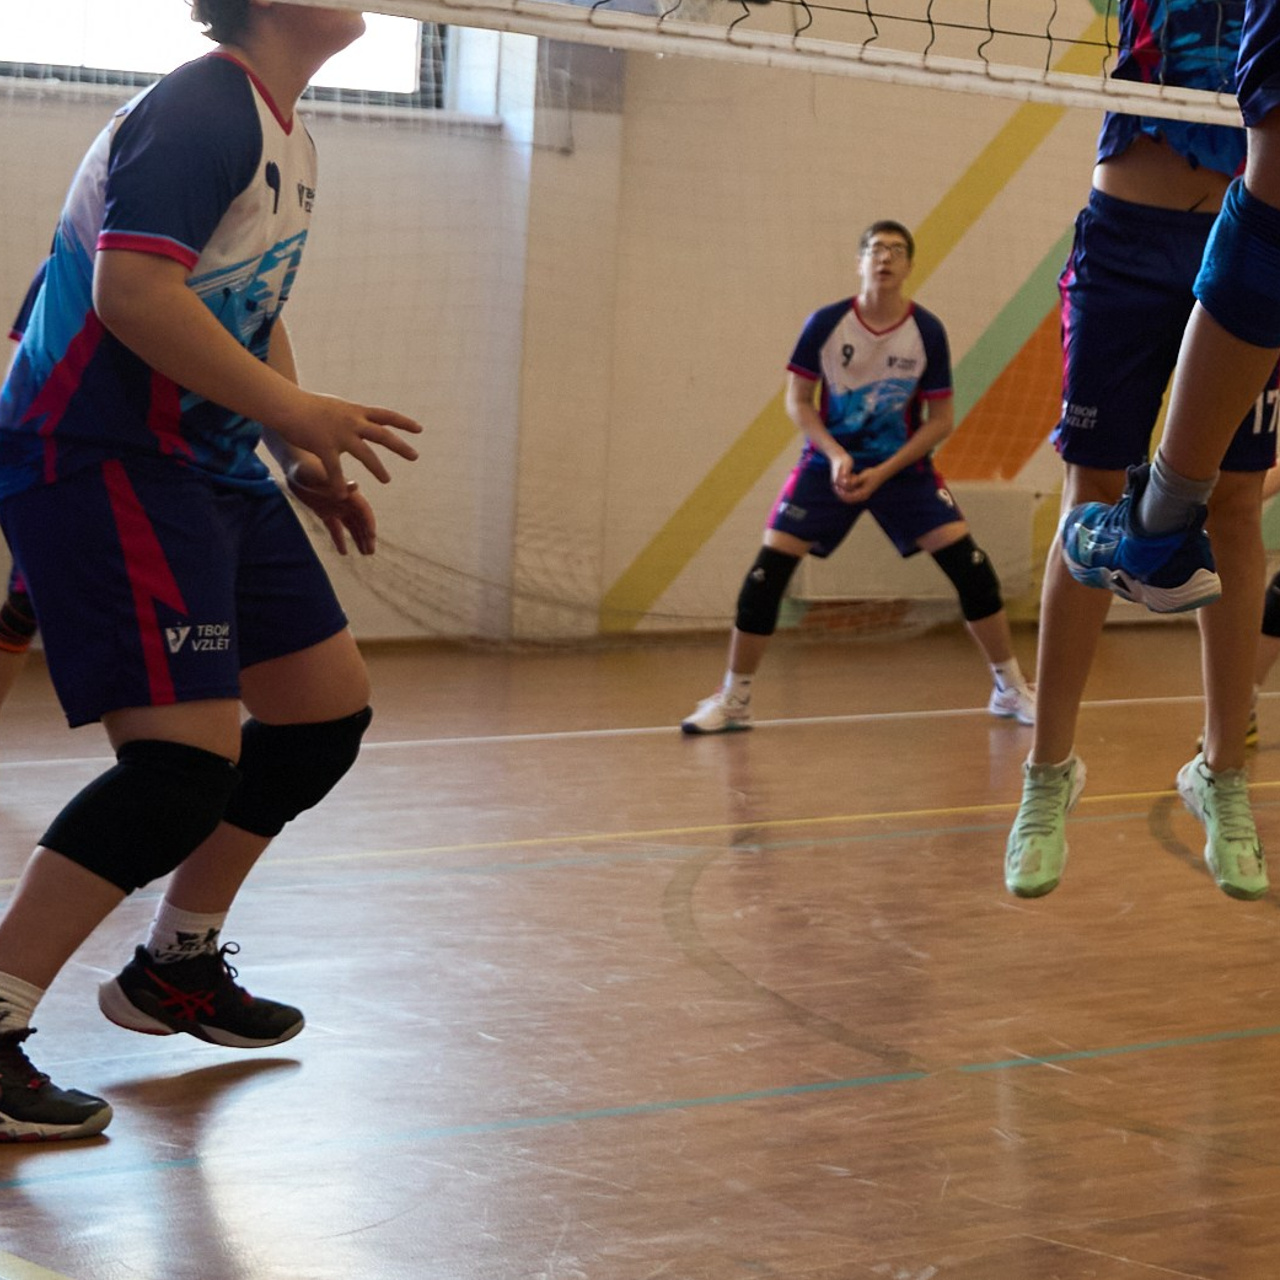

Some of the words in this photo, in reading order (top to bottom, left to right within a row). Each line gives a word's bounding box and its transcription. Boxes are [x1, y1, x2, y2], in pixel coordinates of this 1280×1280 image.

[842, 344, 854, 368] 9
[1253, 390, 1280, 434] 17
[197, 622, 230, 637] ТВОЙ
